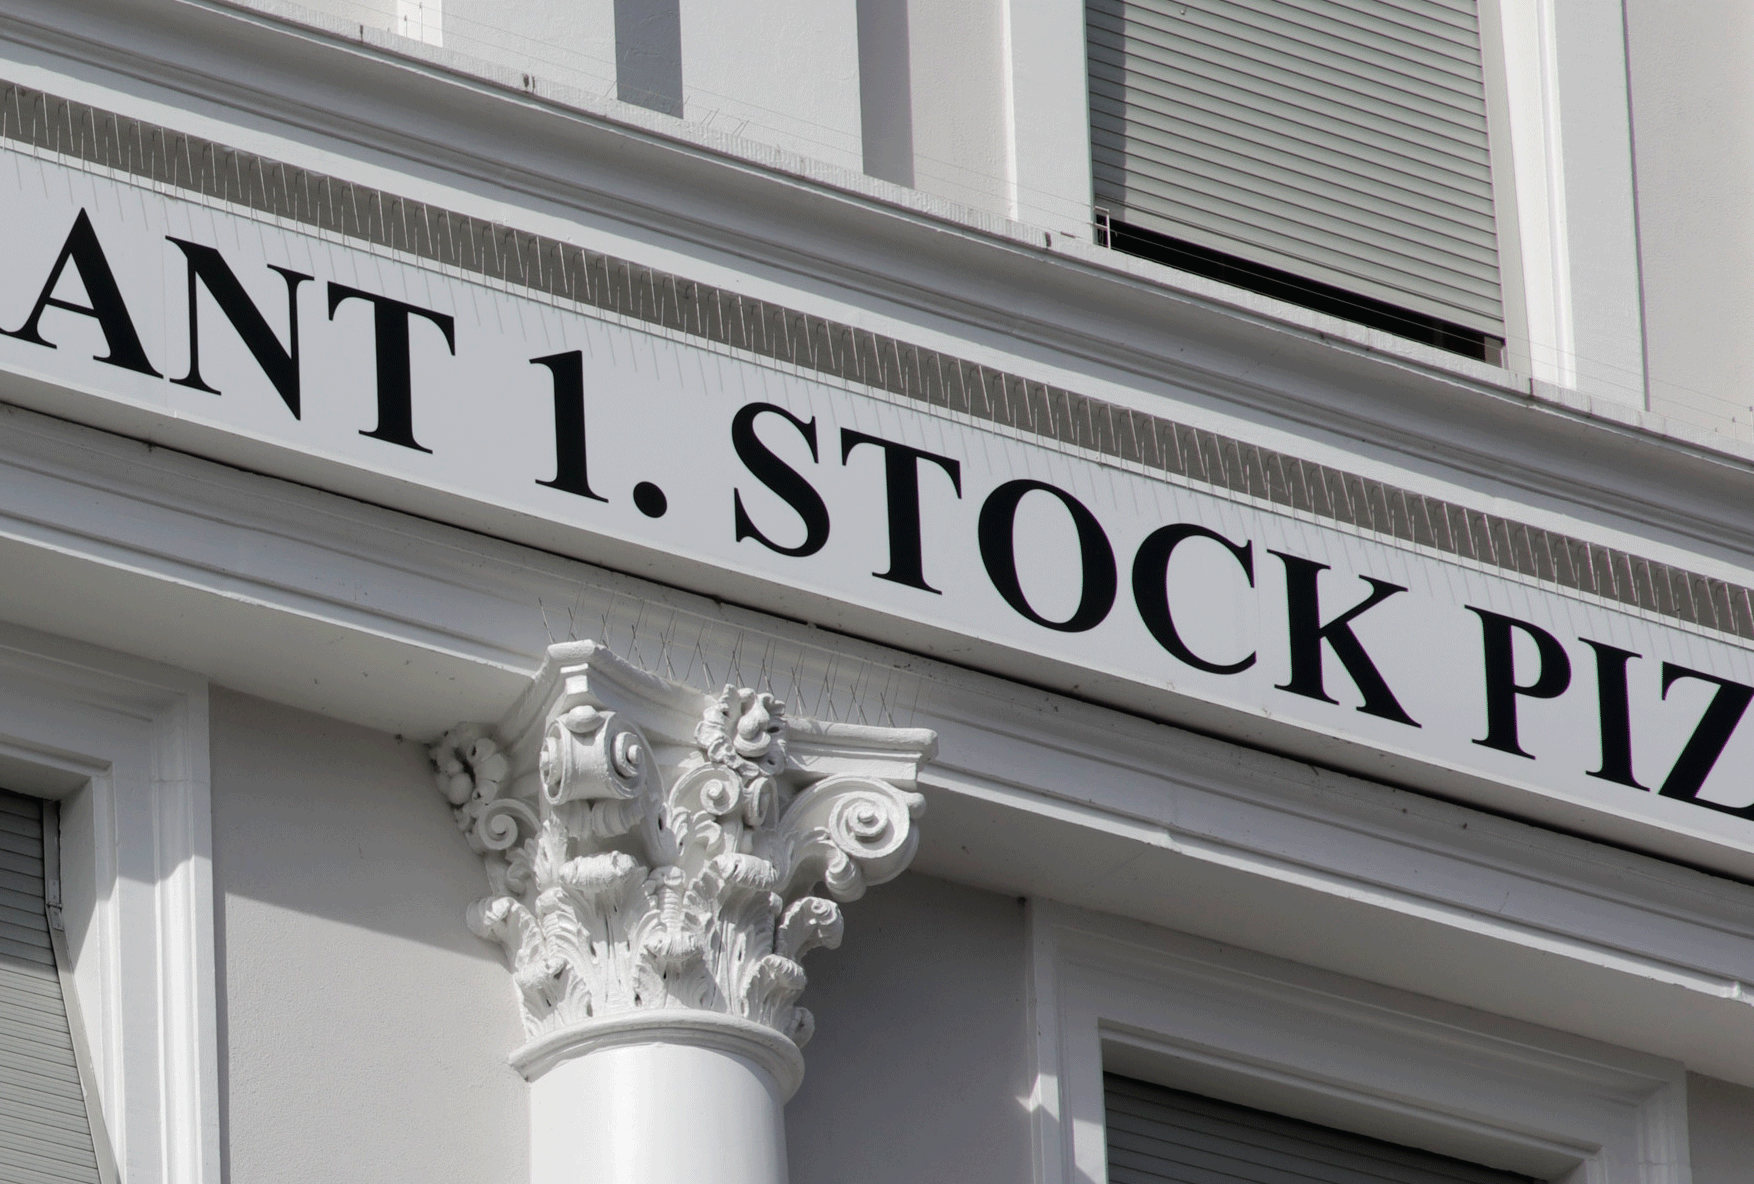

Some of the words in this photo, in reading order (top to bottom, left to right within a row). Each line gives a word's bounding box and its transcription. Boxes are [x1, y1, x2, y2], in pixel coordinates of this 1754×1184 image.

[529, 350, 667, 518] 1.
[732, 402, 1421, 728] STOCK
[1465, 605, 1754, 821] PIZ
